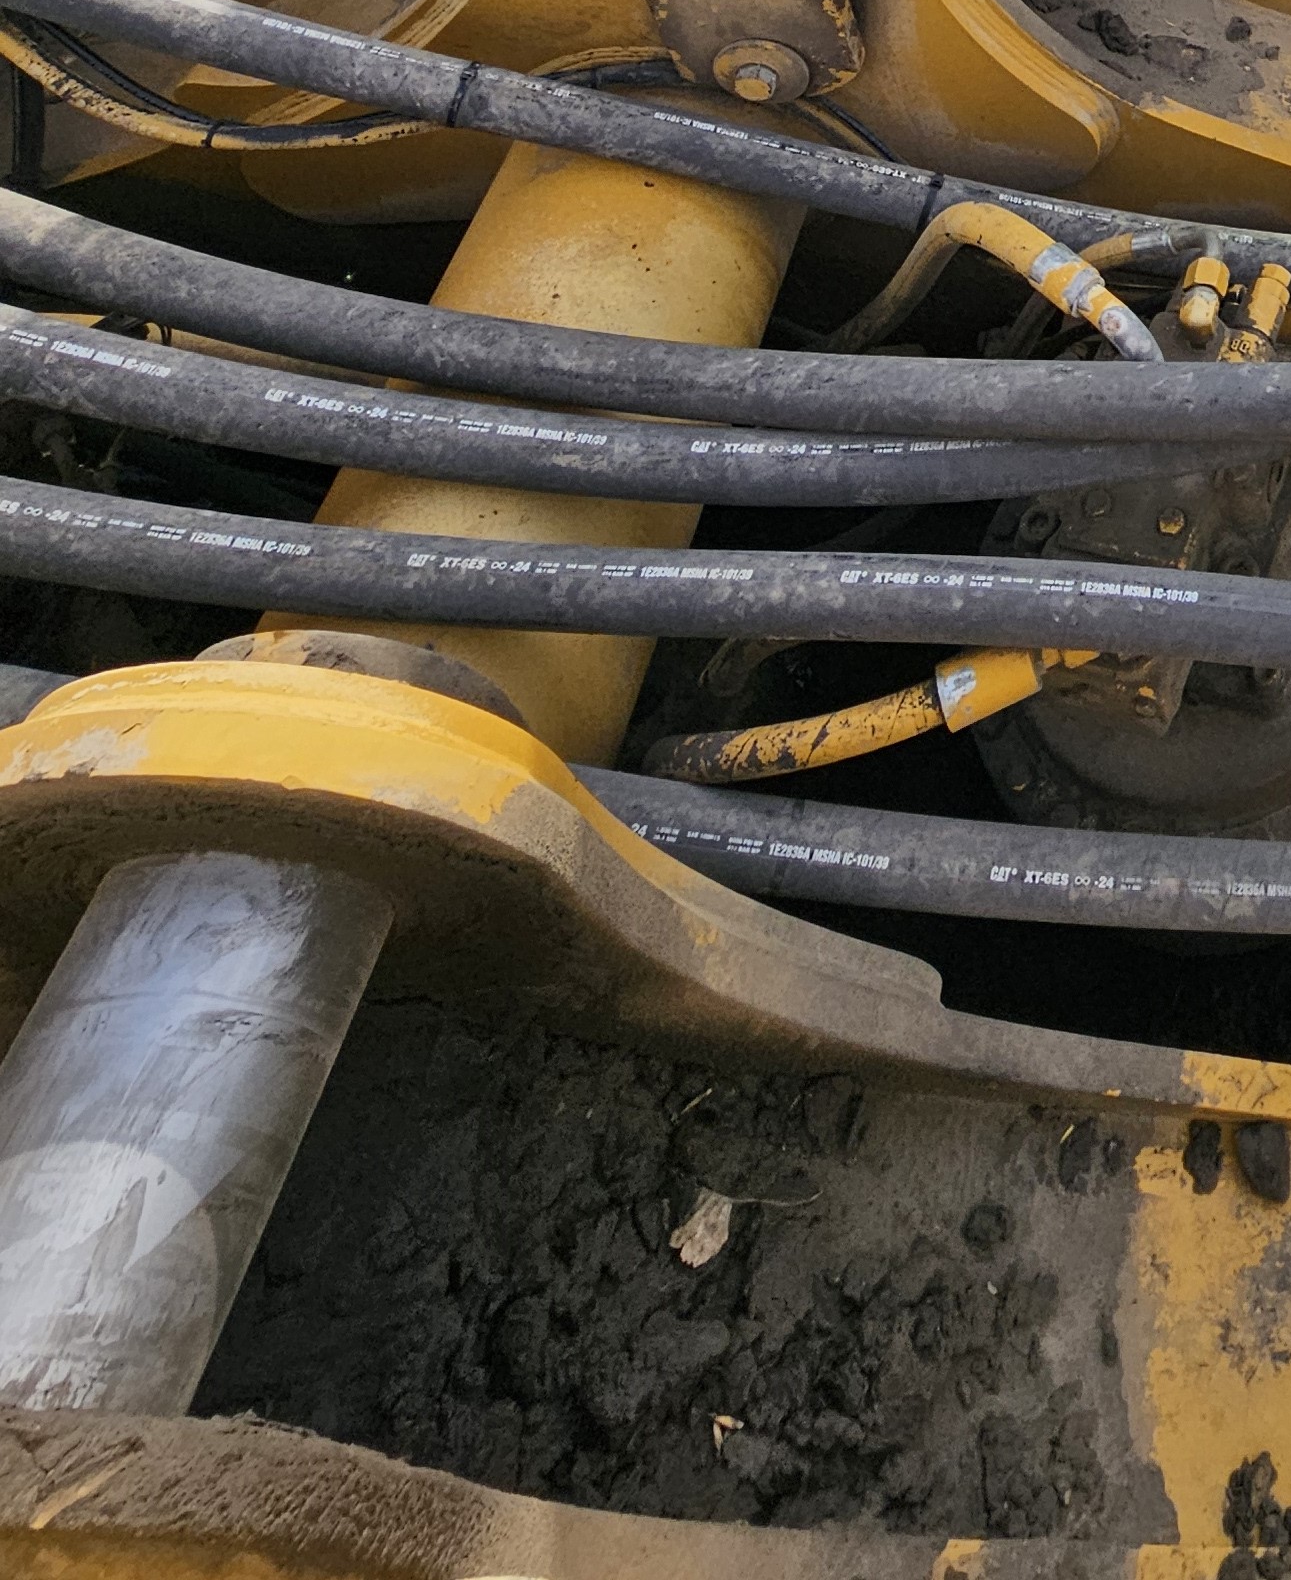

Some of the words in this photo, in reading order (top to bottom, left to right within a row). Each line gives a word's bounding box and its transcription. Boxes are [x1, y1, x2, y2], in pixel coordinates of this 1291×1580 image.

[262, 539, 312, 557] IC-101/39
[1151, 587, 1199, 604] IC-101/39
[768, 843, 811, 861] 1E2836A
[811, 848, 841, 864] MSHA
[841, 851, 890, 870] IC-101/39
[1024, 870, 1070, 886] XT-6ES
